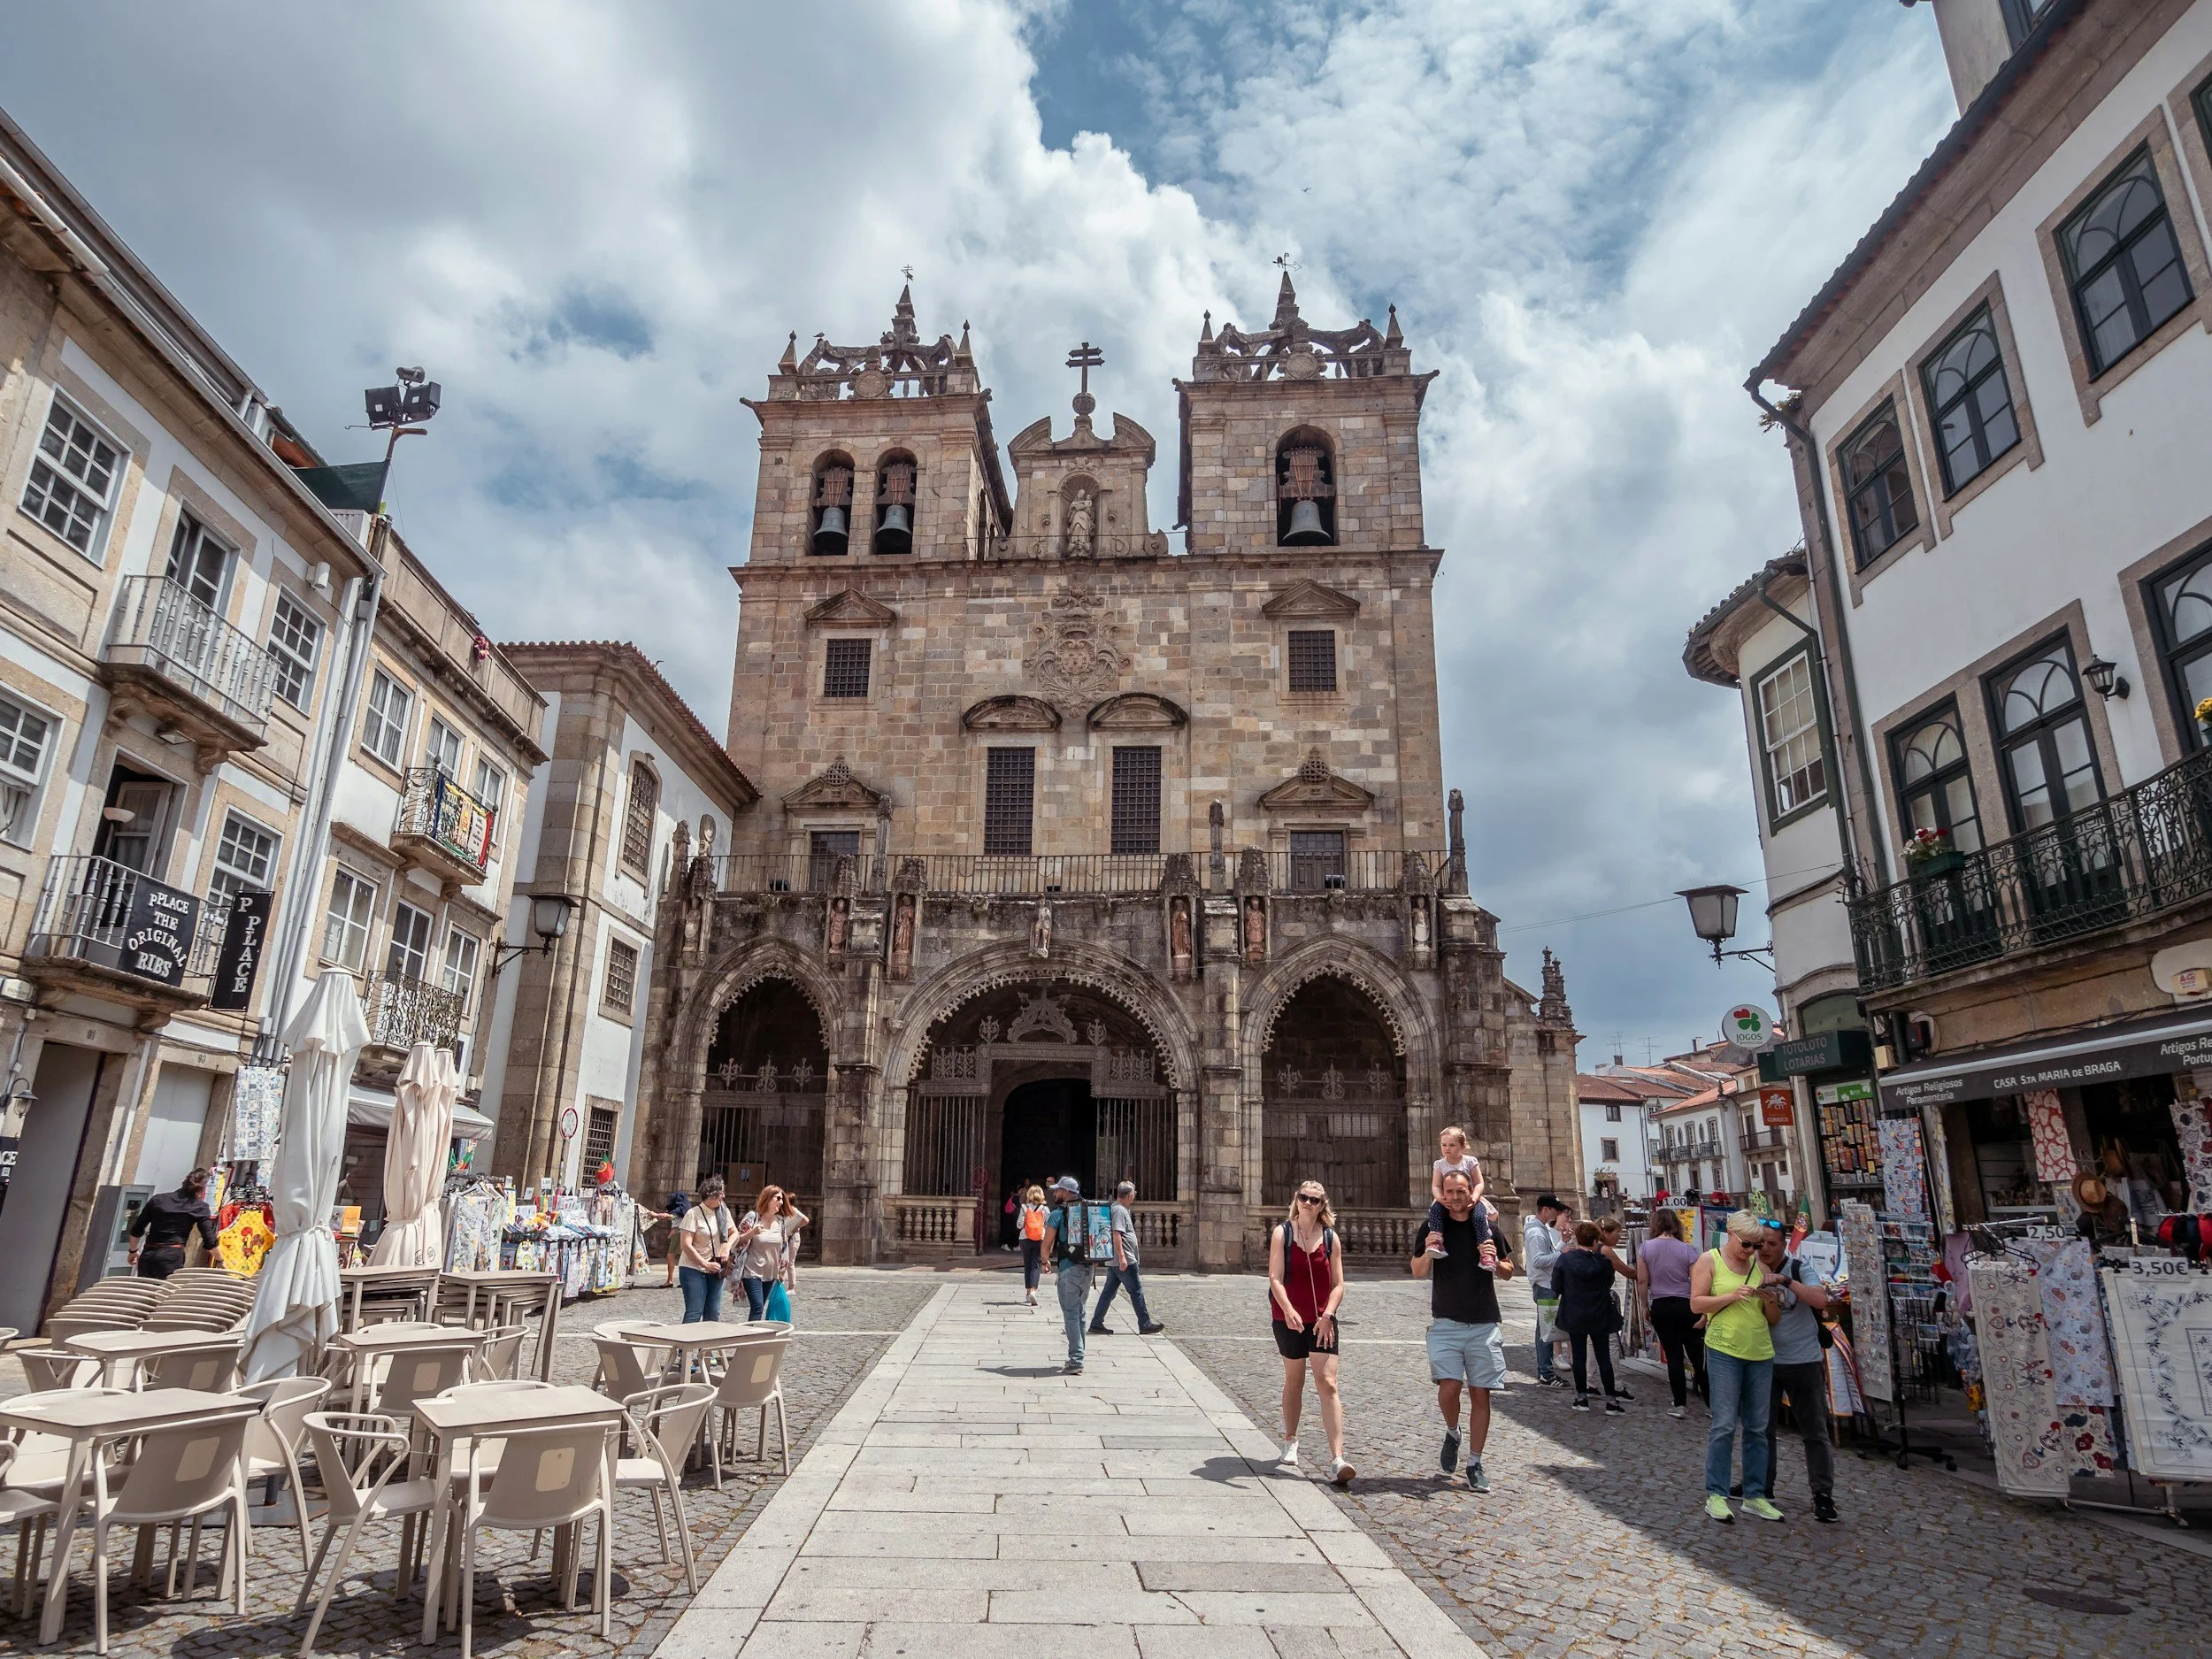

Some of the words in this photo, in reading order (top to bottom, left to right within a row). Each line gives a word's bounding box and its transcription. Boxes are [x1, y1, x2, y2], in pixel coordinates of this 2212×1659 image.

[153, 910, 179, 931] THE
[128, 927, 188, 968] ORIGINAL
[135, 951, 173, 978] RIBS
[1736, 1033, 1763, 1043] JOGOS
[1782, 1036, 1827, 1056] TOTOLOTO
[2160, 1041, 2197, 1056] Artigos
[1784, 1053, 1825, 1071] LOTARIAS
[2183, 1053, 2212, 1066] Portu
[1993, 1077, 2017, 1089] CASA
[2038, 1068, 2070, 1082] MARIA
[2071, 1068, 2083, 1078] DE
[2084, 1061, 2122, 1076] BRAGA
[1895, 1084, 1922, 1096] Artigos
[1924, 1079, 1963, 1092] Religiosos
[1906, 1091, 1955, 1105] Paramentaria
[0, 1150, 19, 1166] CE
[2028, 1225, 2066, 1240] 2,50
[2132, 1261, 2188, 1277] 3,50€
